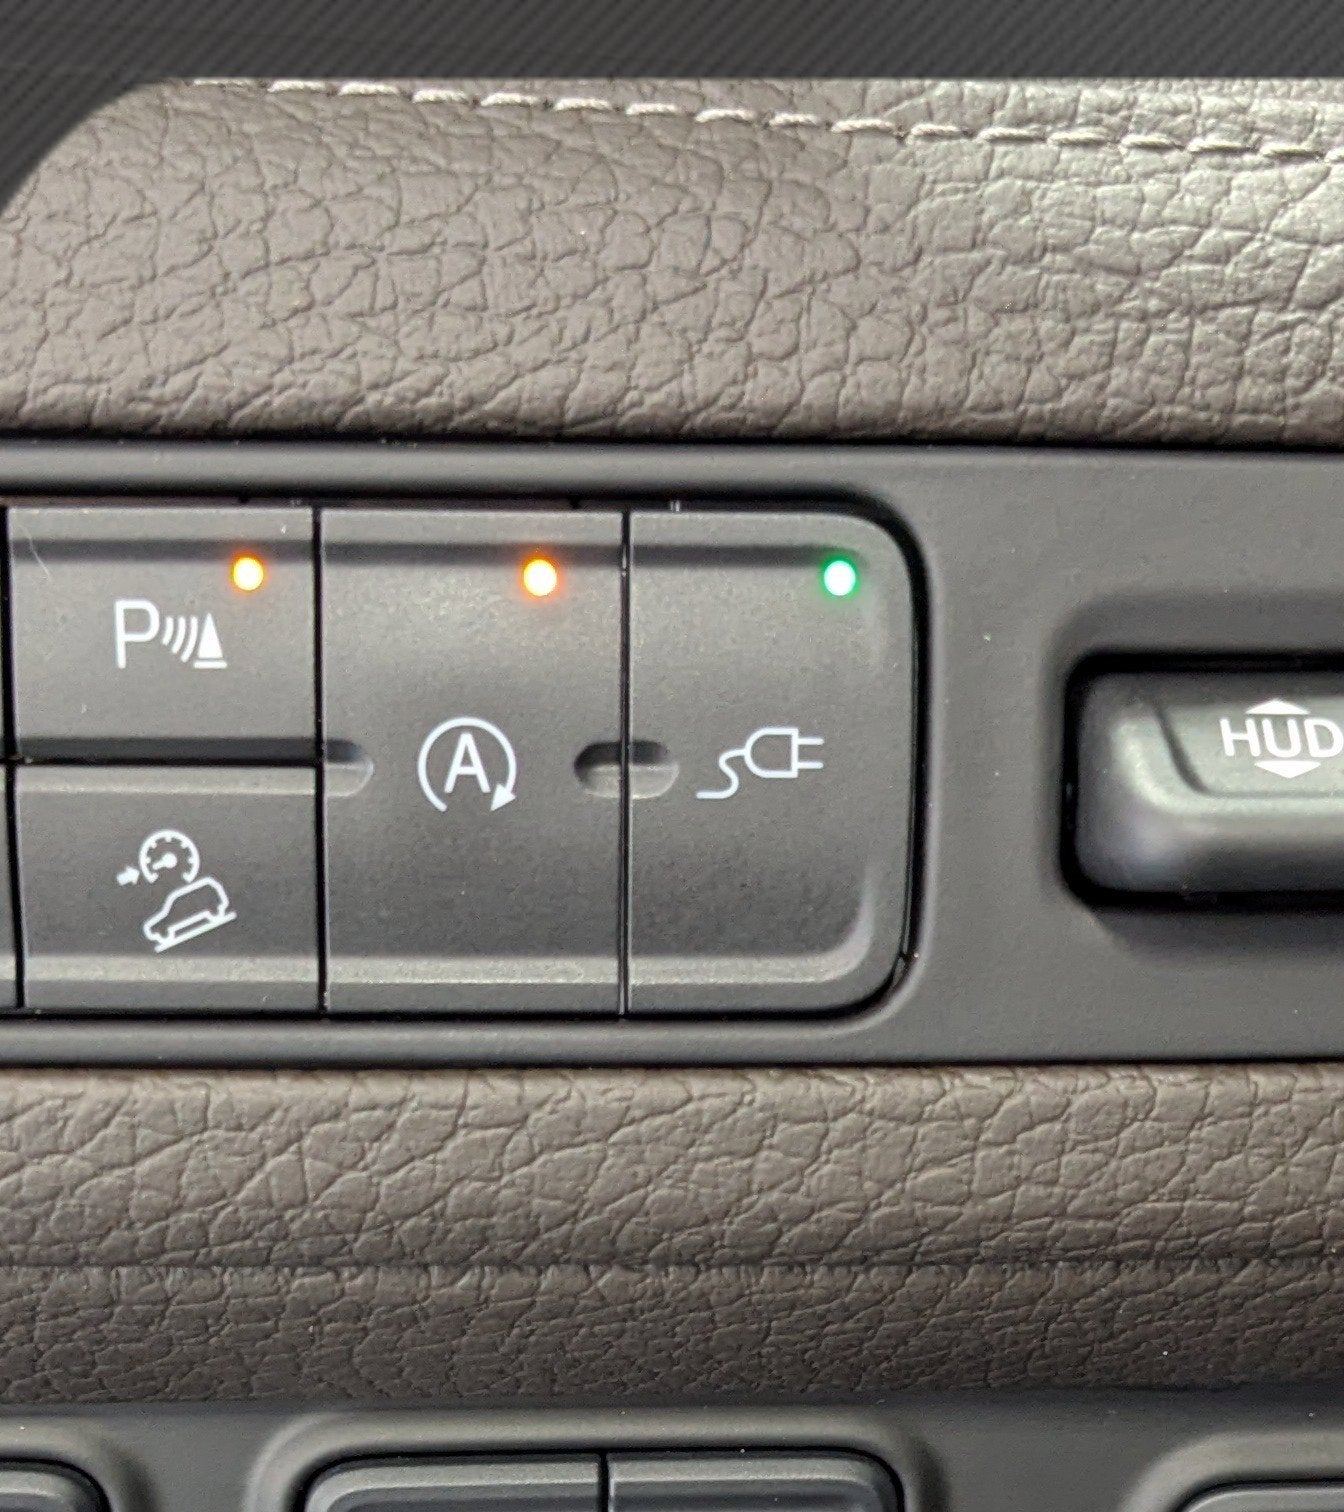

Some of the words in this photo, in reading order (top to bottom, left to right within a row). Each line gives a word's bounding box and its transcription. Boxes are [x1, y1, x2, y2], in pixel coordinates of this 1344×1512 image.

[114, 598, 160, 669] P
[443, 732, 491, 795] A
[1219, 717, 1344, 758] HUD
